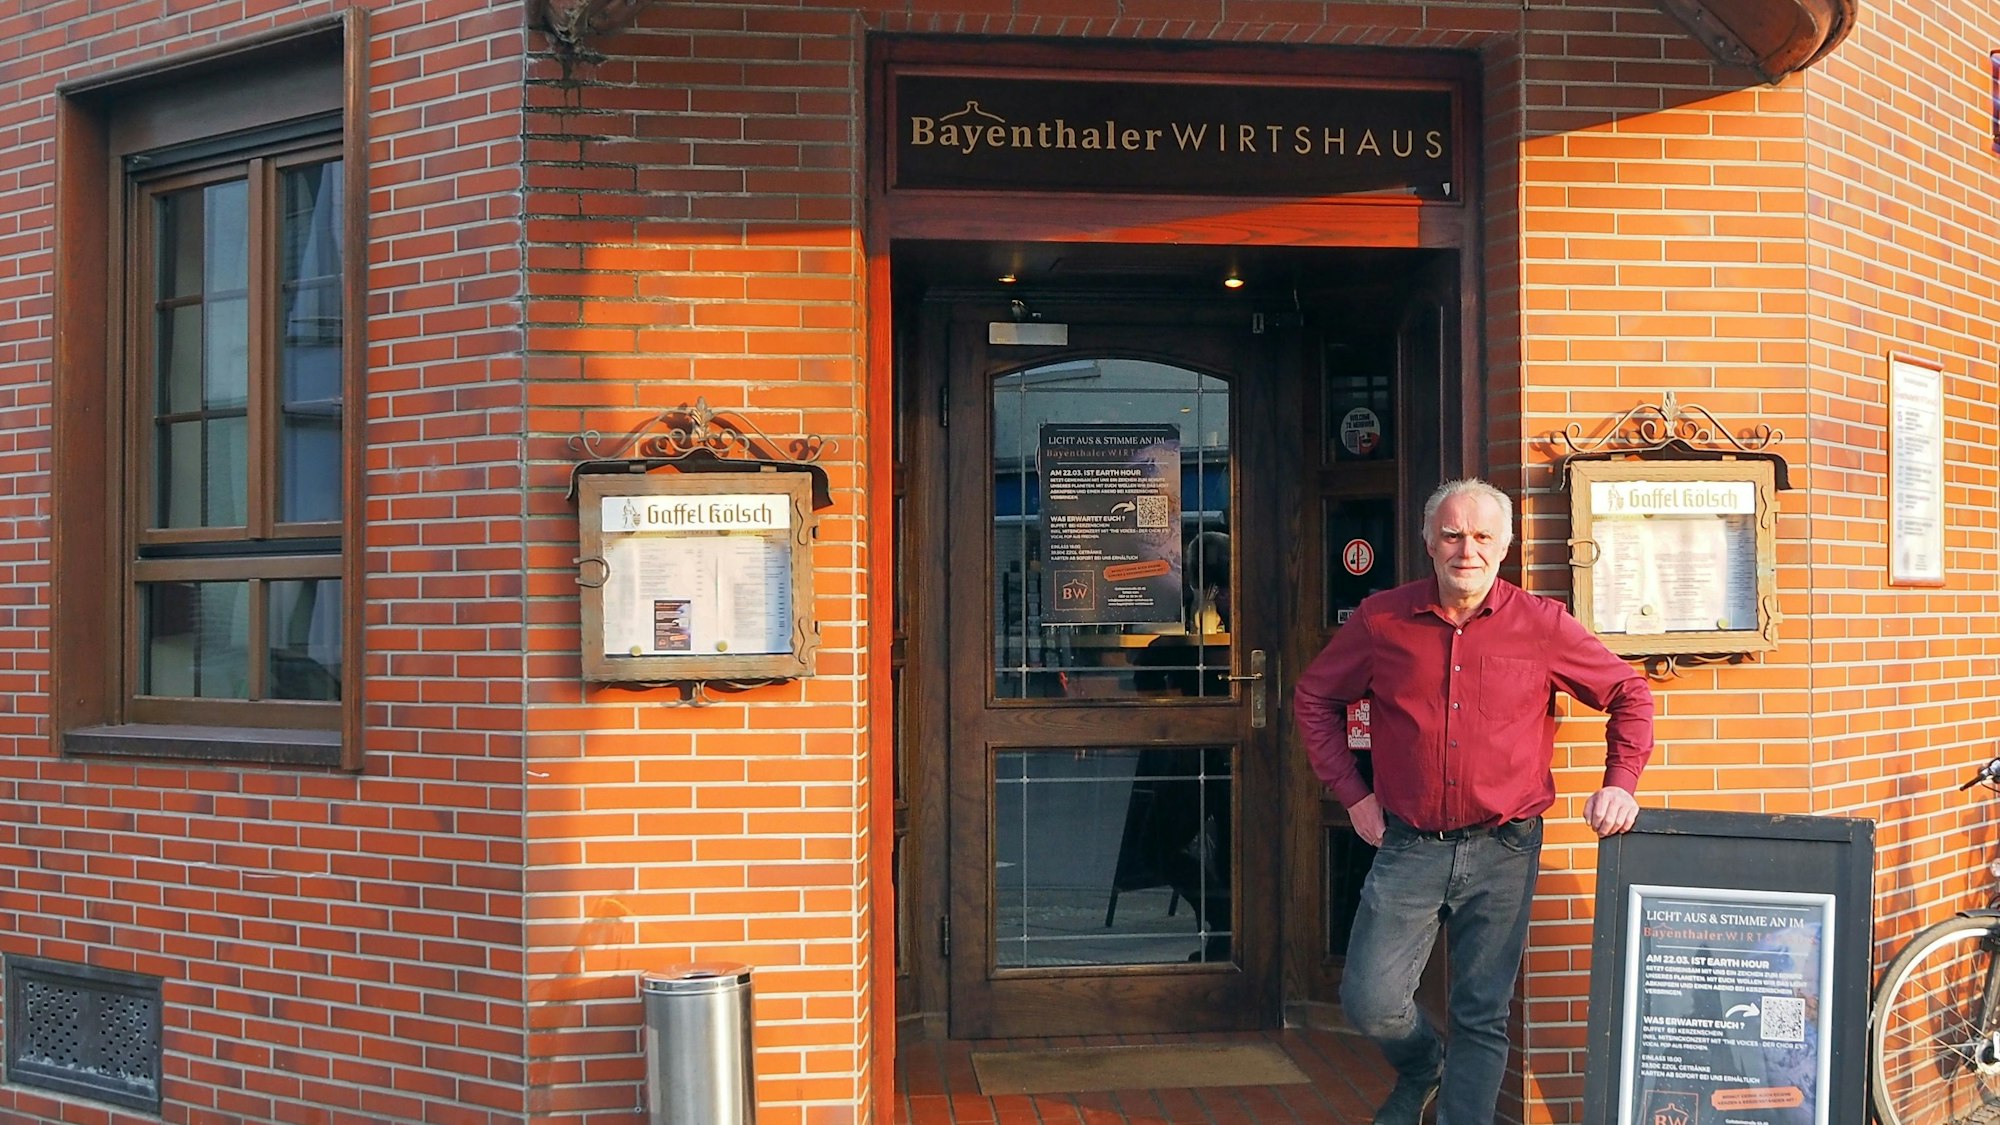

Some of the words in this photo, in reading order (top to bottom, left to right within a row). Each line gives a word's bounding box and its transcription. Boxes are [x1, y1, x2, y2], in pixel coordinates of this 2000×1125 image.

[911, 116, 1162, 154] Bayenthaler
[1171, 123, 1443, 159] WIRTSHAUS
[1048, 436, 1075, 444] LICHT
[1077, 436, 1094, 444] AUS
[1095, 436, 1102, 444] &
[1104, 436, 1138, 444] STIMME
[1139, 436, 1152, 444] AN
[1154, 436, 1165, 444] IM
[1046, 449, 1106, 458] Bayenthaler
[1630, 488, 1678, 509] Gaffel
[1683, 488, 1738, 509] Kölsch
[648, 503, 704, 525] Gaffel
[709, 502, 772, 525] Kölsch
[1063, 588, 1087, 599] BW
[1361, 700, 1370, 711] ke
[1355, 709, 1370, 721] Rau
[1646, 911, 1682, 921] LICHT
[1684, 913, 1706, 923] AUS
[1709, 914, 1718, 924] &
[1720, 914, 1767, 926] STIMME
[1770, 917, 1786, 927] AN
[1790, 918, 1804, 928] IM
[1644, 927, 1723, 941] Bayenthaler
[1646, 954, 1662, 963] AM
[1663, 955, 1689, 965] 22.03.
[1691, 957, 1706, 965] IST
[1707, 957, 1740, 968] EARTH
[1741, 960, 1769, 969] HOUR
[1644, 1016, 1664, 1024] WAS
[1665, 1017, 1713, 1028] ERWARTET
[1715, 1020, 1739, 1029] EUCH
[1655, 1114, 1689, 1125] BW
